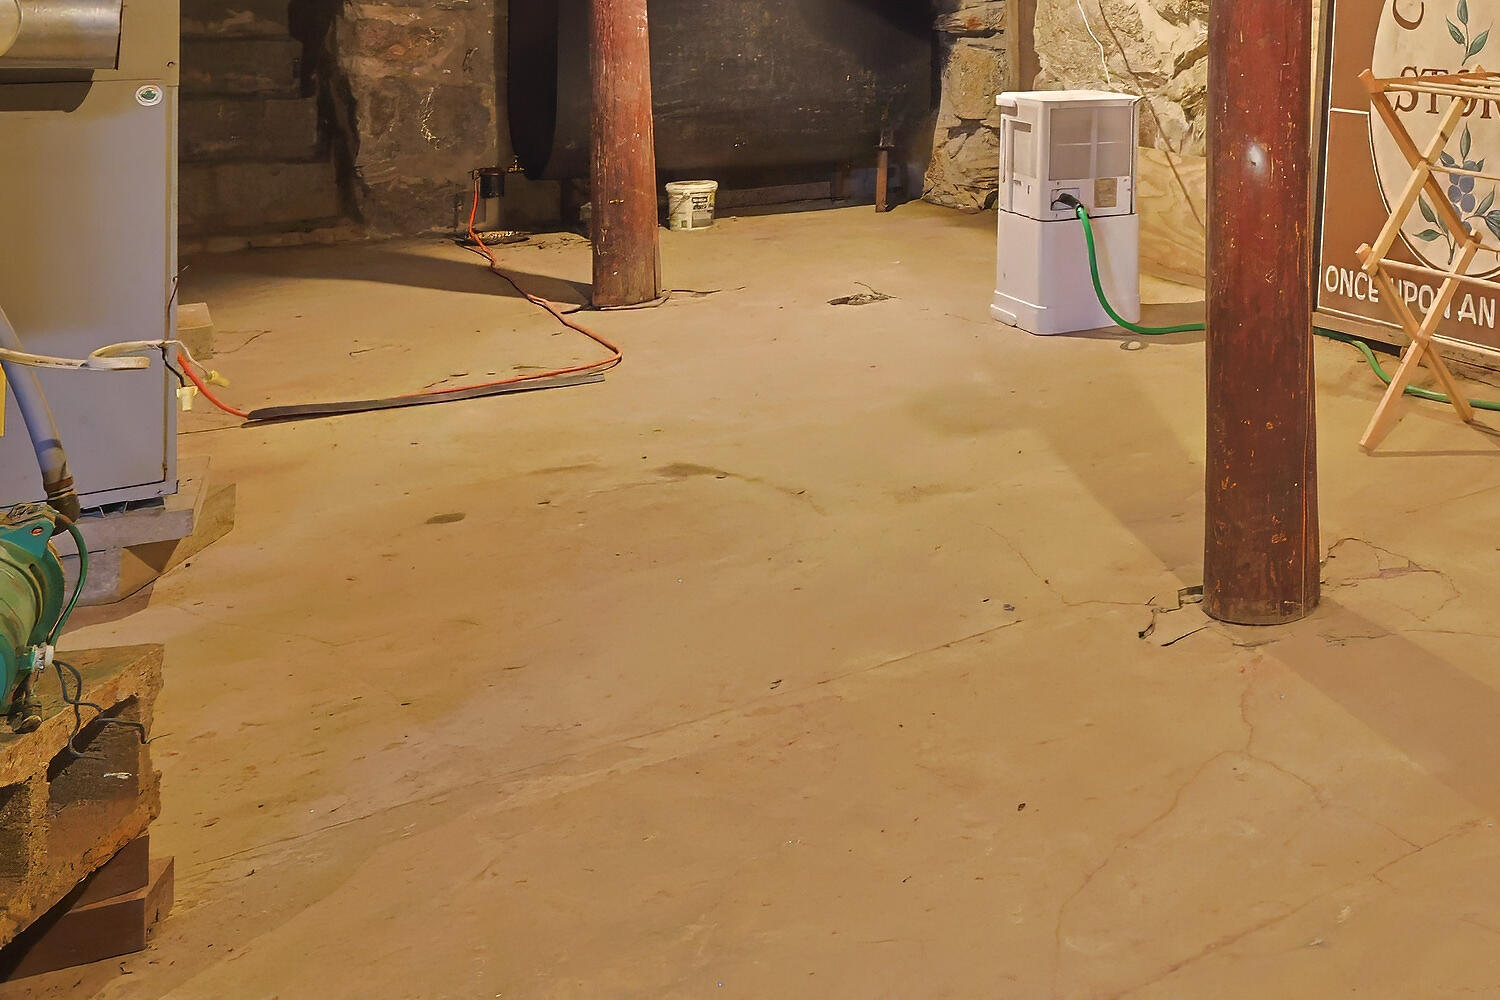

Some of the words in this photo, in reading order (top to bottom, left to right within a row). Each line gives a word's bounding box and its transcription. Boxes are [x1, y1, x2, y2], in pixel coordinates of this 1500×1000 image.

[1325, 264, 1379, 303] ONCE
[1390, 277, 1451, 320] PO
[1457, 293, 1496, 329] AN
